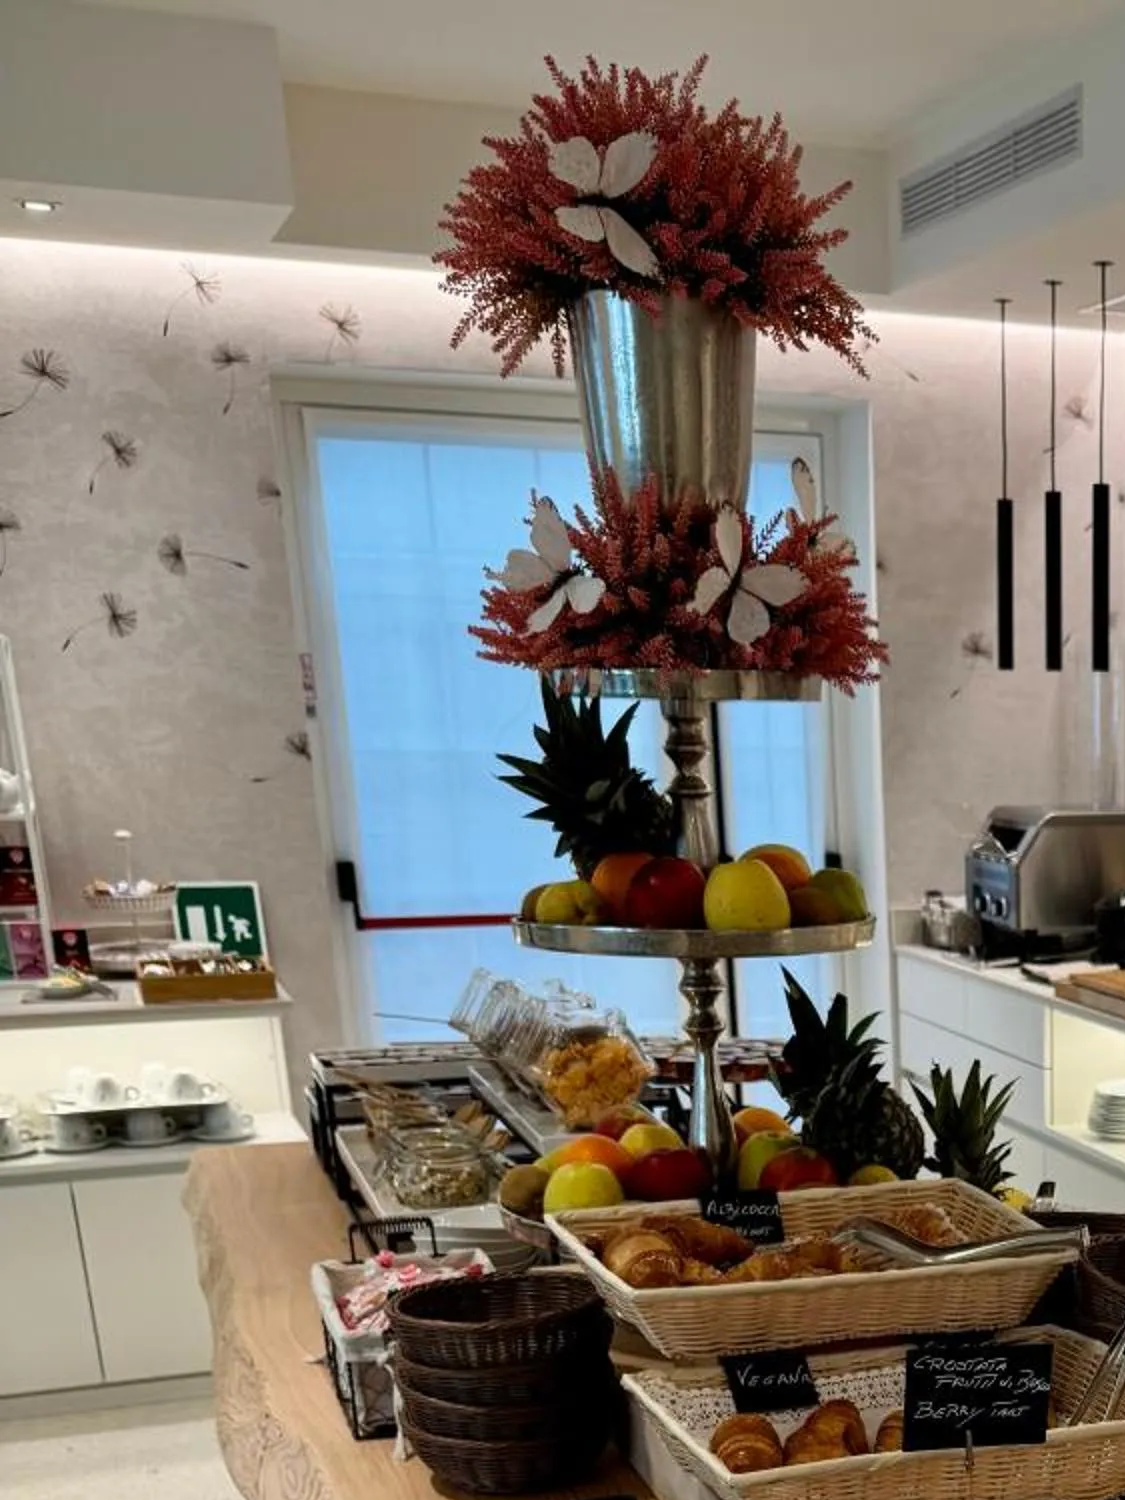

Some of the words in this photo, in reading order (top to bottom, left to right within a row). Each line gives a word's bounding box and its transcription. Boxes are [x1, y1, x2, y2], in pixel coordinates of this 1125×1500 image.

[913, 1355, 1008, 1372] CROSTATA
[736, 1364, 813, 1387] VEGANA
[913, 1401, 985, 1428] BERRY
